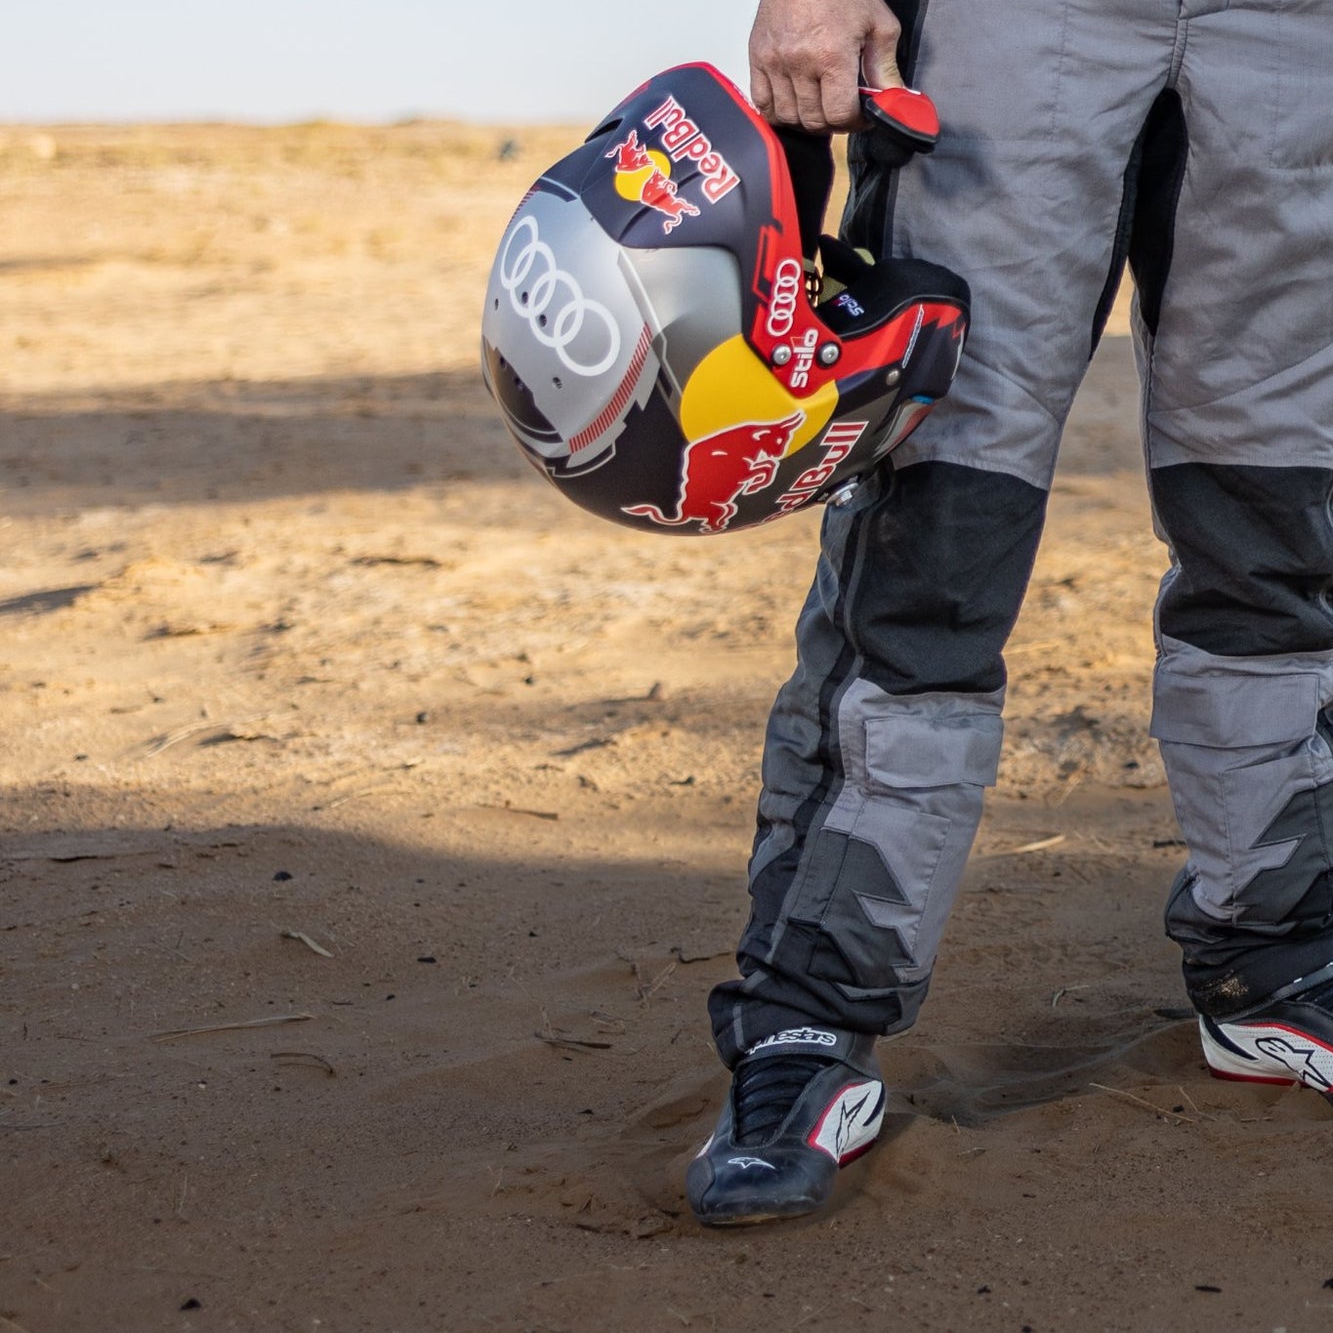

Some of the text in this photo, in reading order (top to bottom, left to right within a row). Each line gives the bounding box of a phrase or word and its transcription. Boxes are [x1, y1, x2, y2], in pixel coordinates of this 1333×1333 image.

[643, 95, 741, 204] Red Bull
[791, 329, 819, 388] Stilo
[789, 421, 869, 491] Bull
